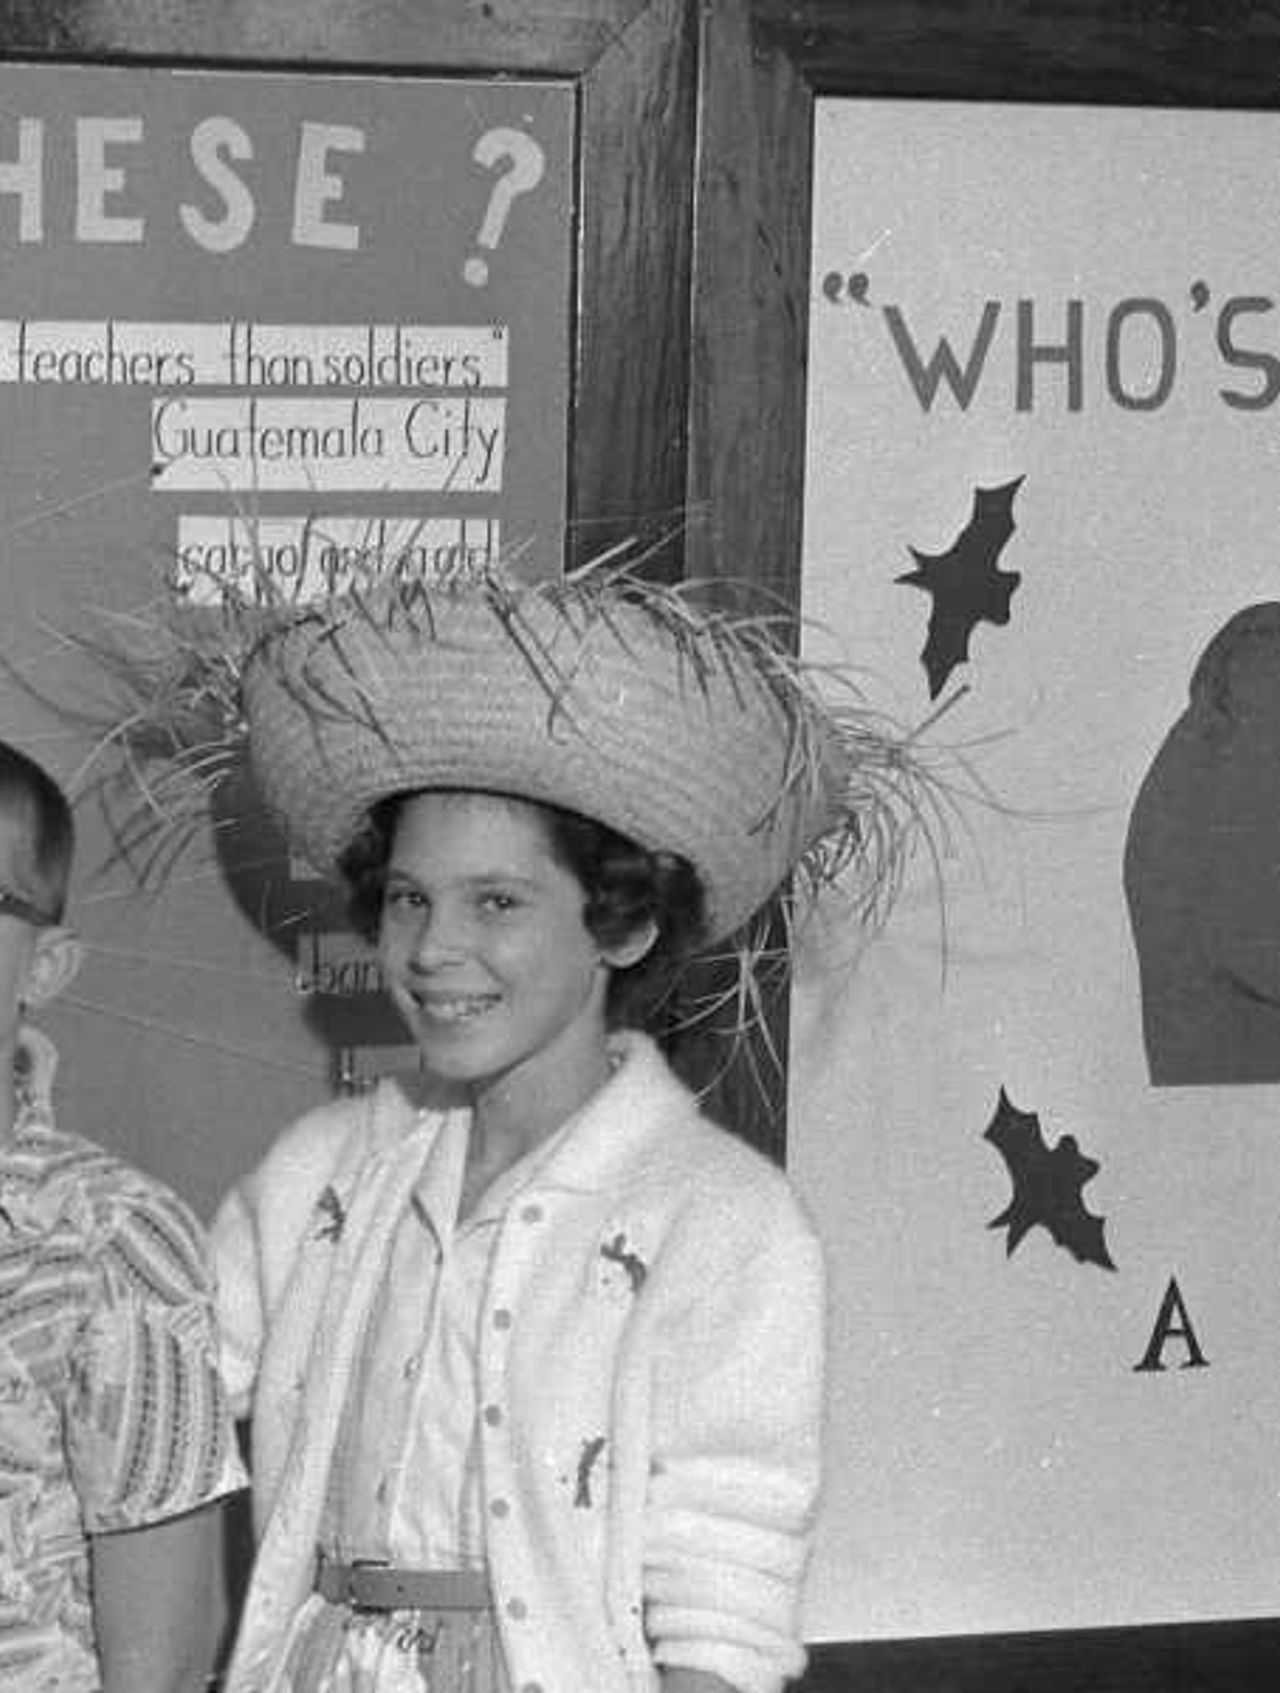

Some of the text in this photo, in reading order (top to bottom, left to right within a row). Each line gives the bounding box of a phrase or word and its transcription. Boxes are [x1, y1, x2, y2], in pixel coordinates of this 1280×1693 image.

[462, 127, 547, 287] ?
[18, 319, 196, 386] teachers
[223, 320, 312, 387] than
[154, 397, 500, 483] Guatemala City
[1132, 1275, 1210, 1372] A
